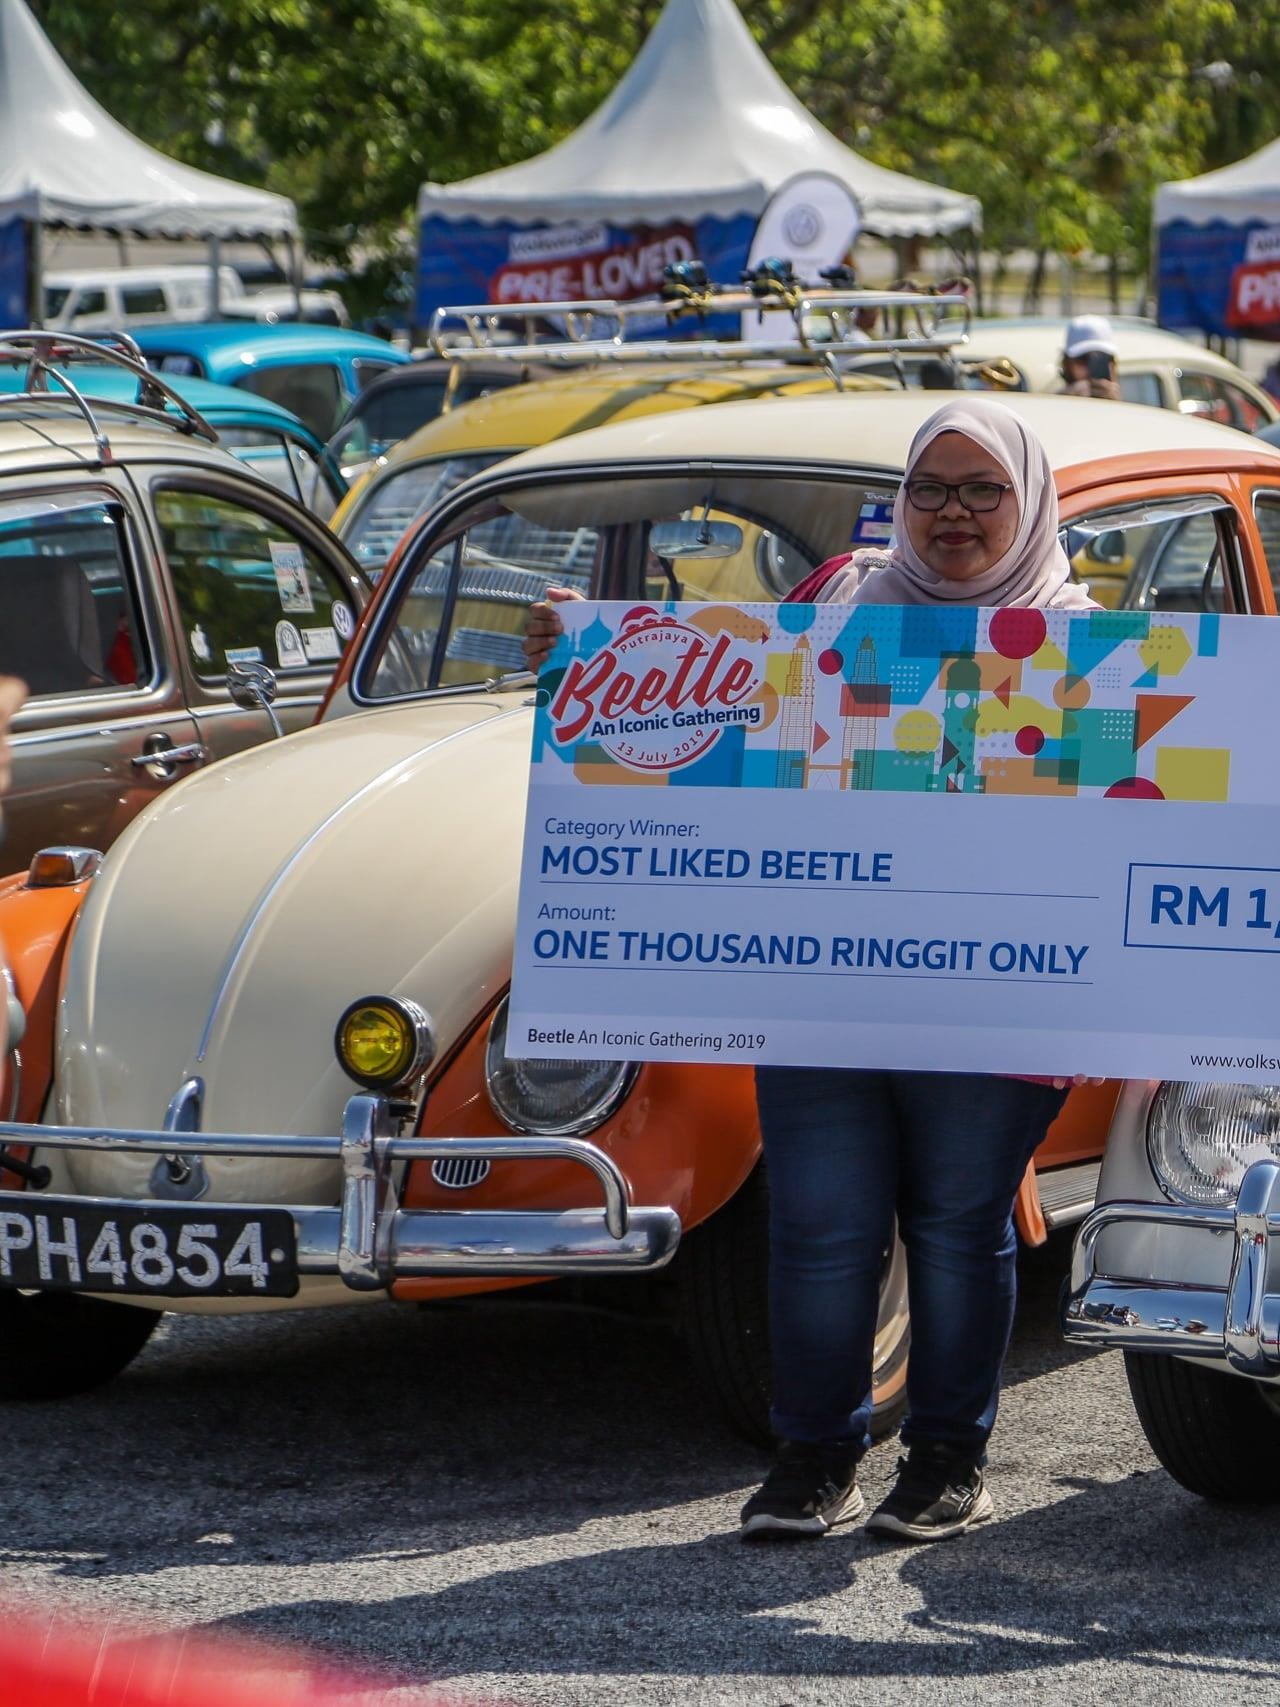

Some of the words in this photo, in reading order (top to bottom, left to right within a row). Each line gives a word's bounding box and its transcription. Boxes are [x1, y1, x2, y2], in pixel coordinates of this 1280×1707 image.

[619, 630, 688, 654] Putrajaya
[551, 634, 755, 743] Beetle
[590, 721, 615, 737] An
[620, 714, 669, 734] Iconic
[672, 705, 760, 728] Gathering
[617, 742, 633, 756] 13
[638, 750, 668, 763] July
[674, 729, 705, 757] 2019
[545, 818, 625, 840] Category
[630, 819, 700, 837] Winner:
[541, 845, 642, 876] MOST
[649, 847, 750, 878] LIKED
[760, 850, 893, 882] BEETLE
[538, 903, 616, 921] Amount:
[1150, 884, 1230, 927] RM
[534, 929, 610, 960] ONE
[618, 931, 821, 965] THOUSAND
[831, 937, 982, 971] RINGGIT
[989, 942, 1090, 974] ONLY
[528, 1029, 574, 1044] Beetle
[577, 1030, 598, 1045] An
[603, 1031, 645, 1046] Iconic
[650, 1031, 723, 1051] Gathering
[727, 1034, 766, 1049] 2019
[0, 1211, 269, 1288] PH4854
